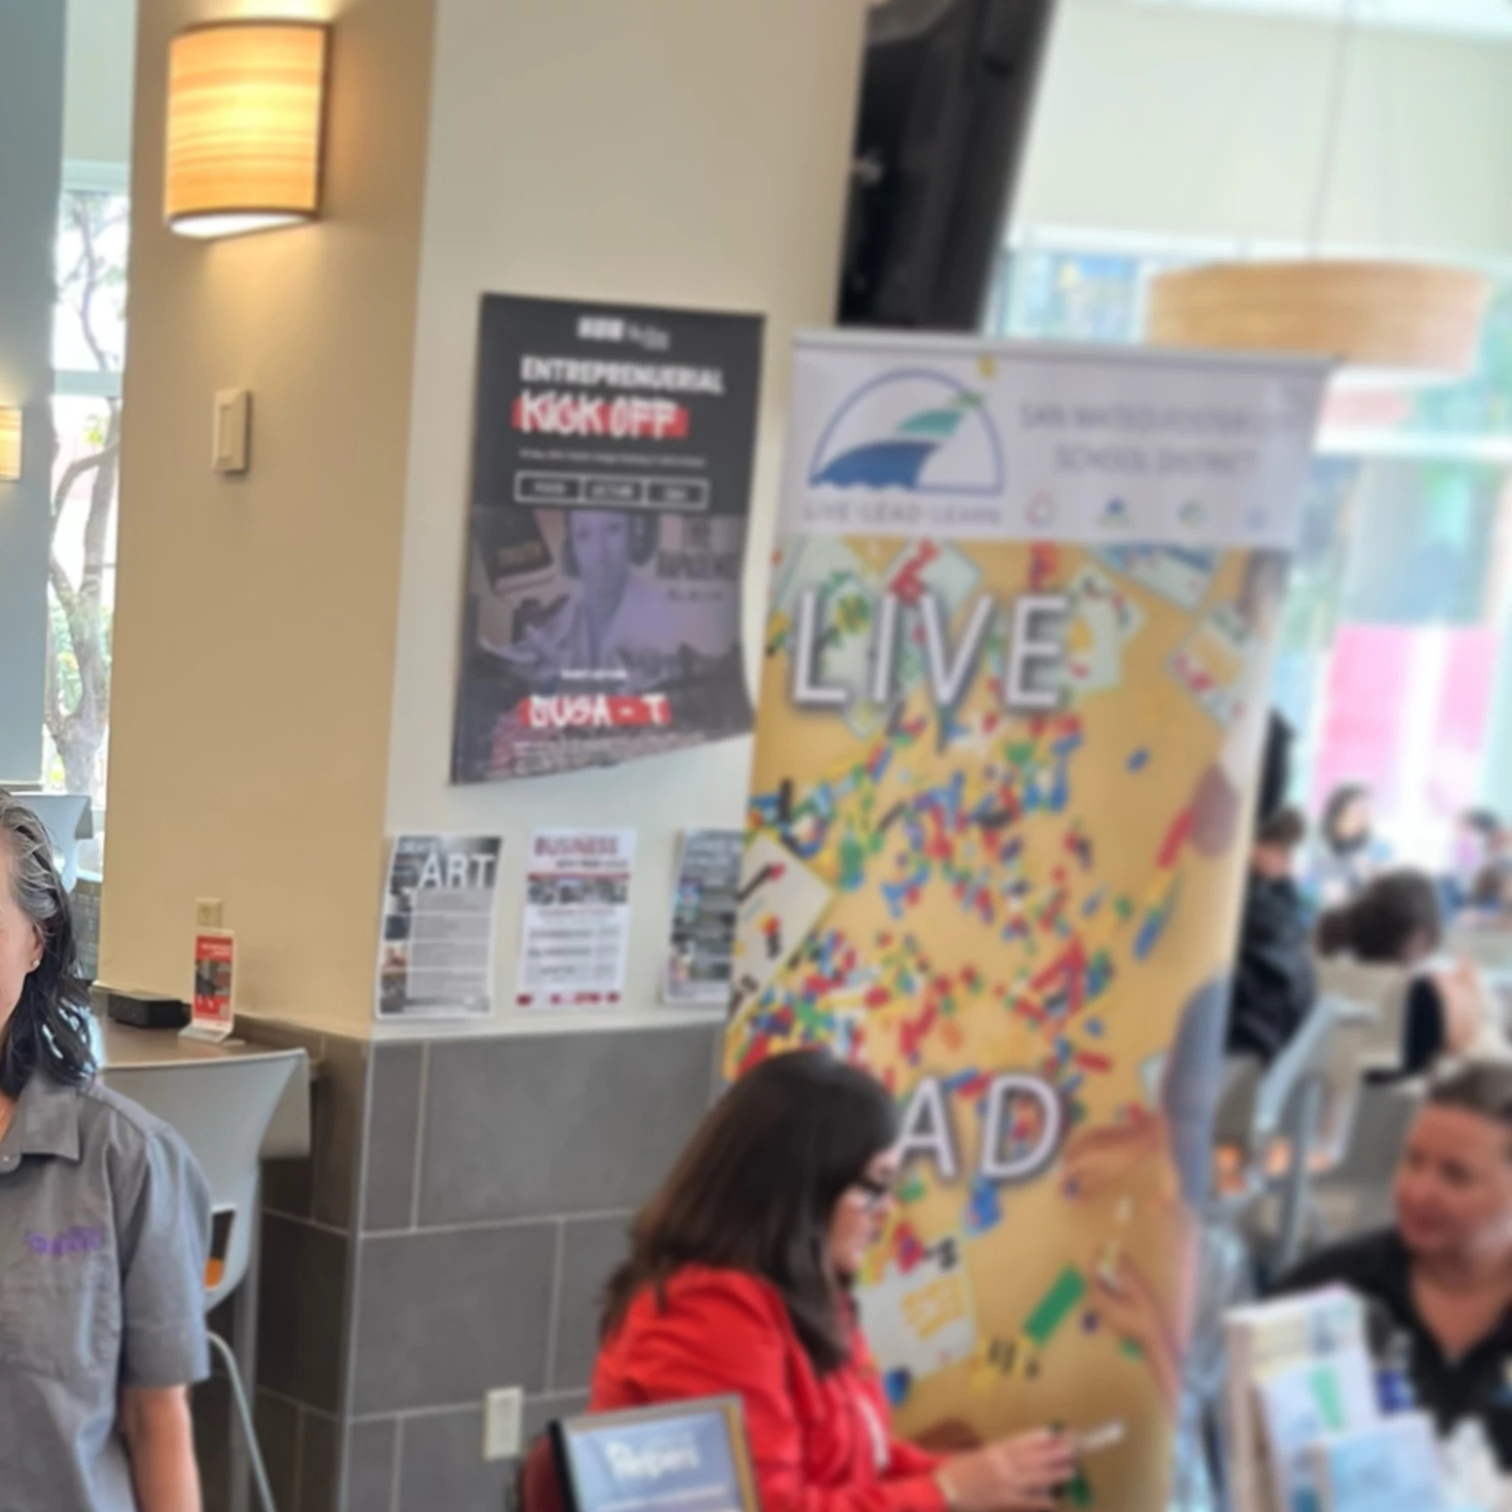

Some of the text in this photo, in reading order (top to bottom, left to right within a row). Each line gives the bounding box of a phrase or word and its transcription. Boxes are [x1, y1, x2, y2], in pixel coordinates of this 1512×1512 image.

[520, 389, 680, 438] KICK OFF
[791, 592, 1069, 707] LIVE
[417, 851, 497, 888] ART
[534, 837, 618, 857] BUSINESS
[894, 1073, 1062, 1179] AD
